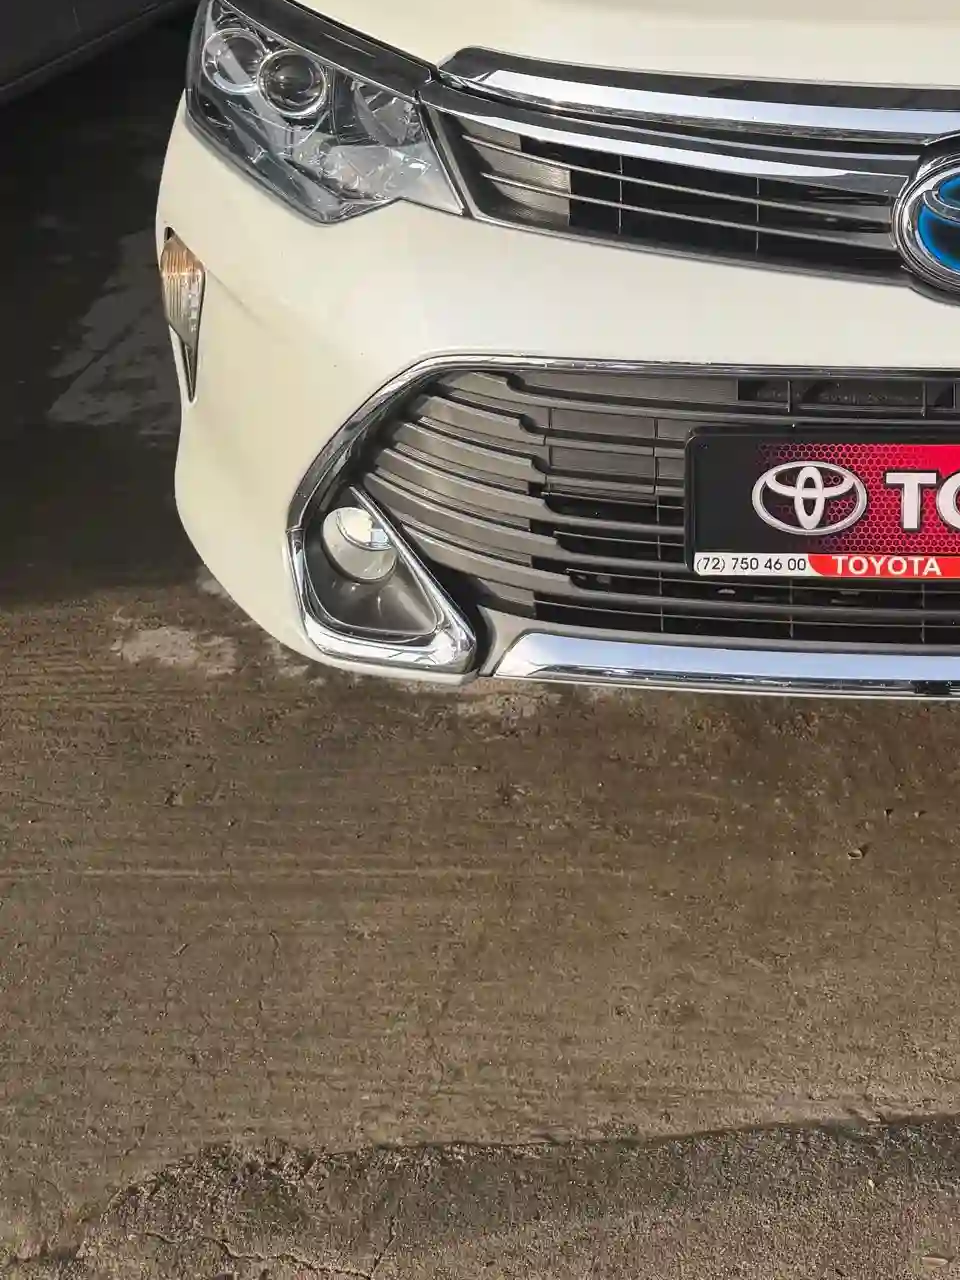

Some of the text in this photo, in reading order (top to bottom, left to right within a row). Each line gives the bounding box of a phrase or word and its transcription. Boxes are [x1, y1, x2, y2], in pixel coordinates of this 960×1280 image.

[696, 557, 807, 573] (72) 750 46 00
[831, 555, 942, 576] TOYOTA
